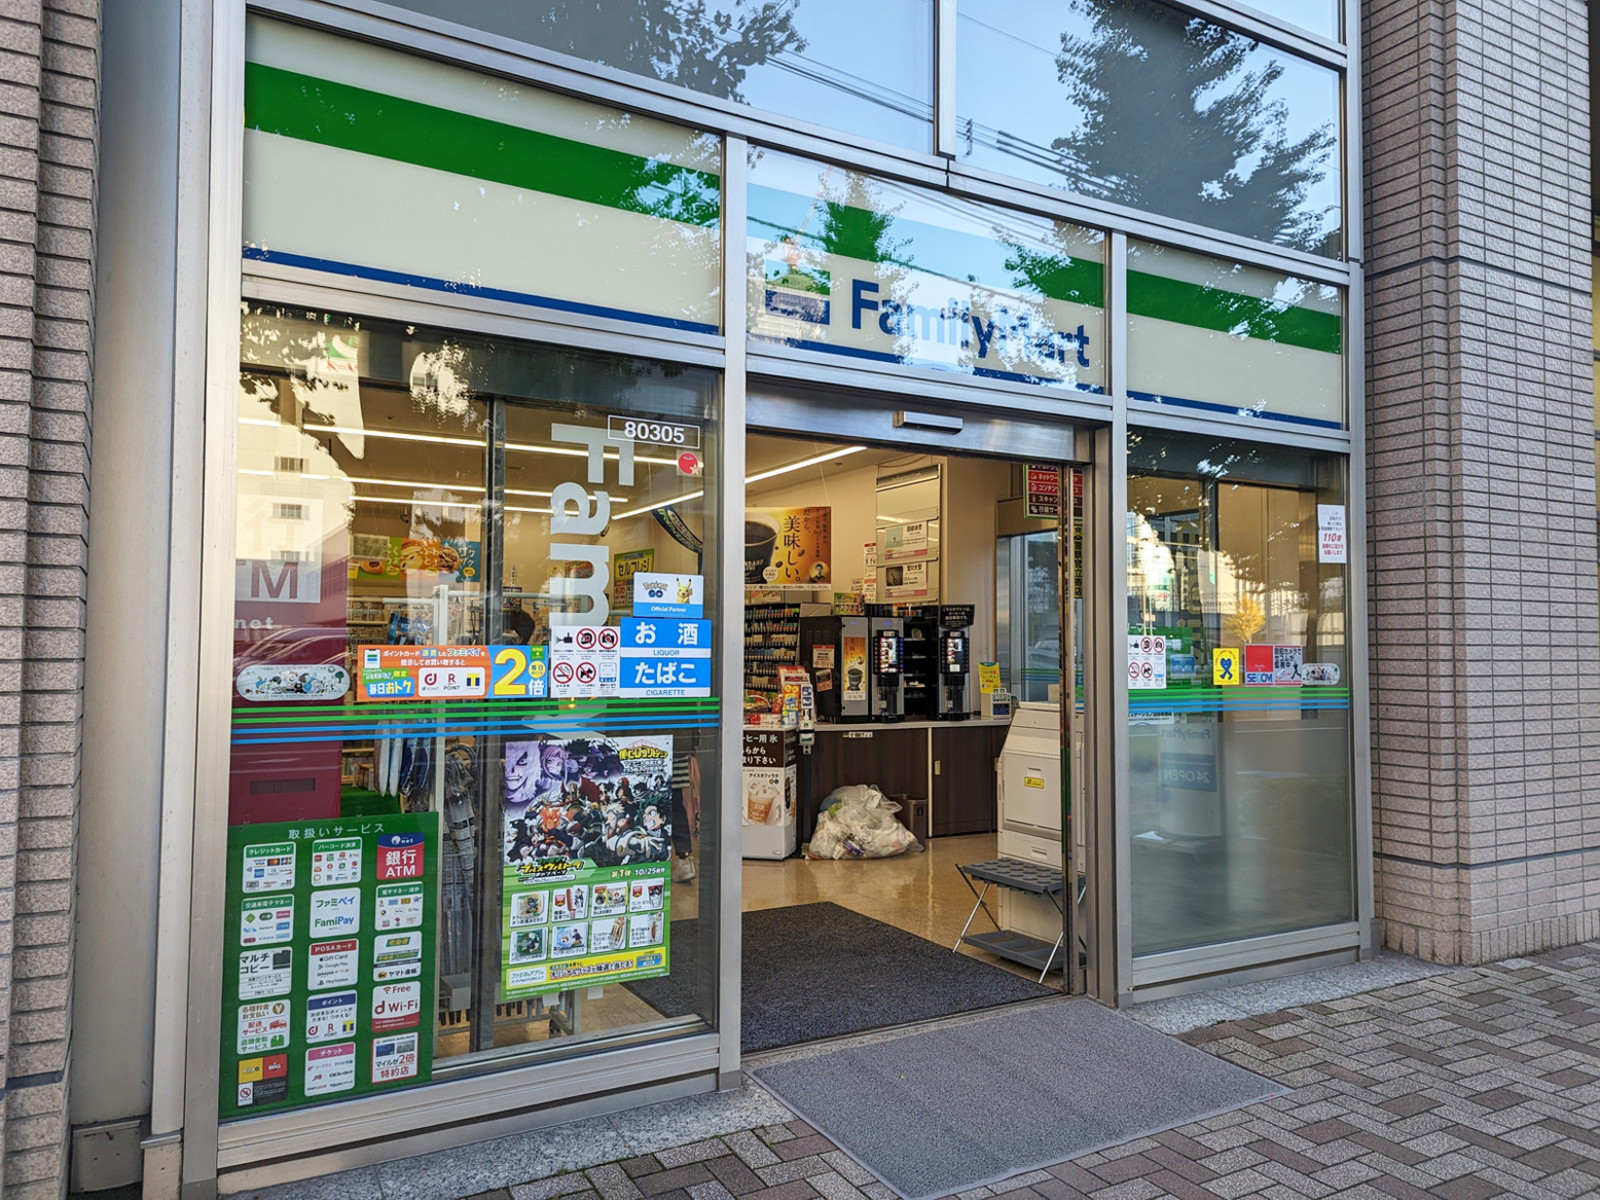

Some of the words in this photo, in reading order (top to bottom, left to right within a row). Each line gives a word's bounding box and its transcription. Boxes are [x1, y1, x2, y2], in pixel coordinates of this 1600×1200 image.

[852, 279, 1090, 368] FamilyMart
[624, 421, 685, 443] 80305
[783, 515, 801, 582] 美味しい。
[236, 560, 298, 599] M
[648, 589, 663, 598] GO
[635, 621, 699, 646] お酒
[448, 673, 455, 683] R
[634, 661, 696, 685] たばこ
[1246, 673, 1273, 683] SECOM
[369, 679, 412, 695] 毎日おトク
[288, 823, 385, 840] 取扱いサービス
[248, 846, 292, 856] クレジットカード
[385, 849, 417, 866] 銀行
[385, 865, 416, 878] ATM
[315, 896, 355, 908] ファミペイ
[314, 916, 354, 928] FamiPay
[315, 943, 353, 953] POSAカード
[240, 952, 270, 964] マルチ
[240, 963, 270, 974] コピー
[392, 985, 412, 993] Free
[321, 997, 343, 1006] ポイント
[388, 999, 418, 1013] Wi-Fi
[242, 1026, 268, 1036] サービス
[241, 1043, 268, 1052] サービス
[320, 1047, 343, 1057] チケット
[380, 1066, 409, 1079] 特約店
